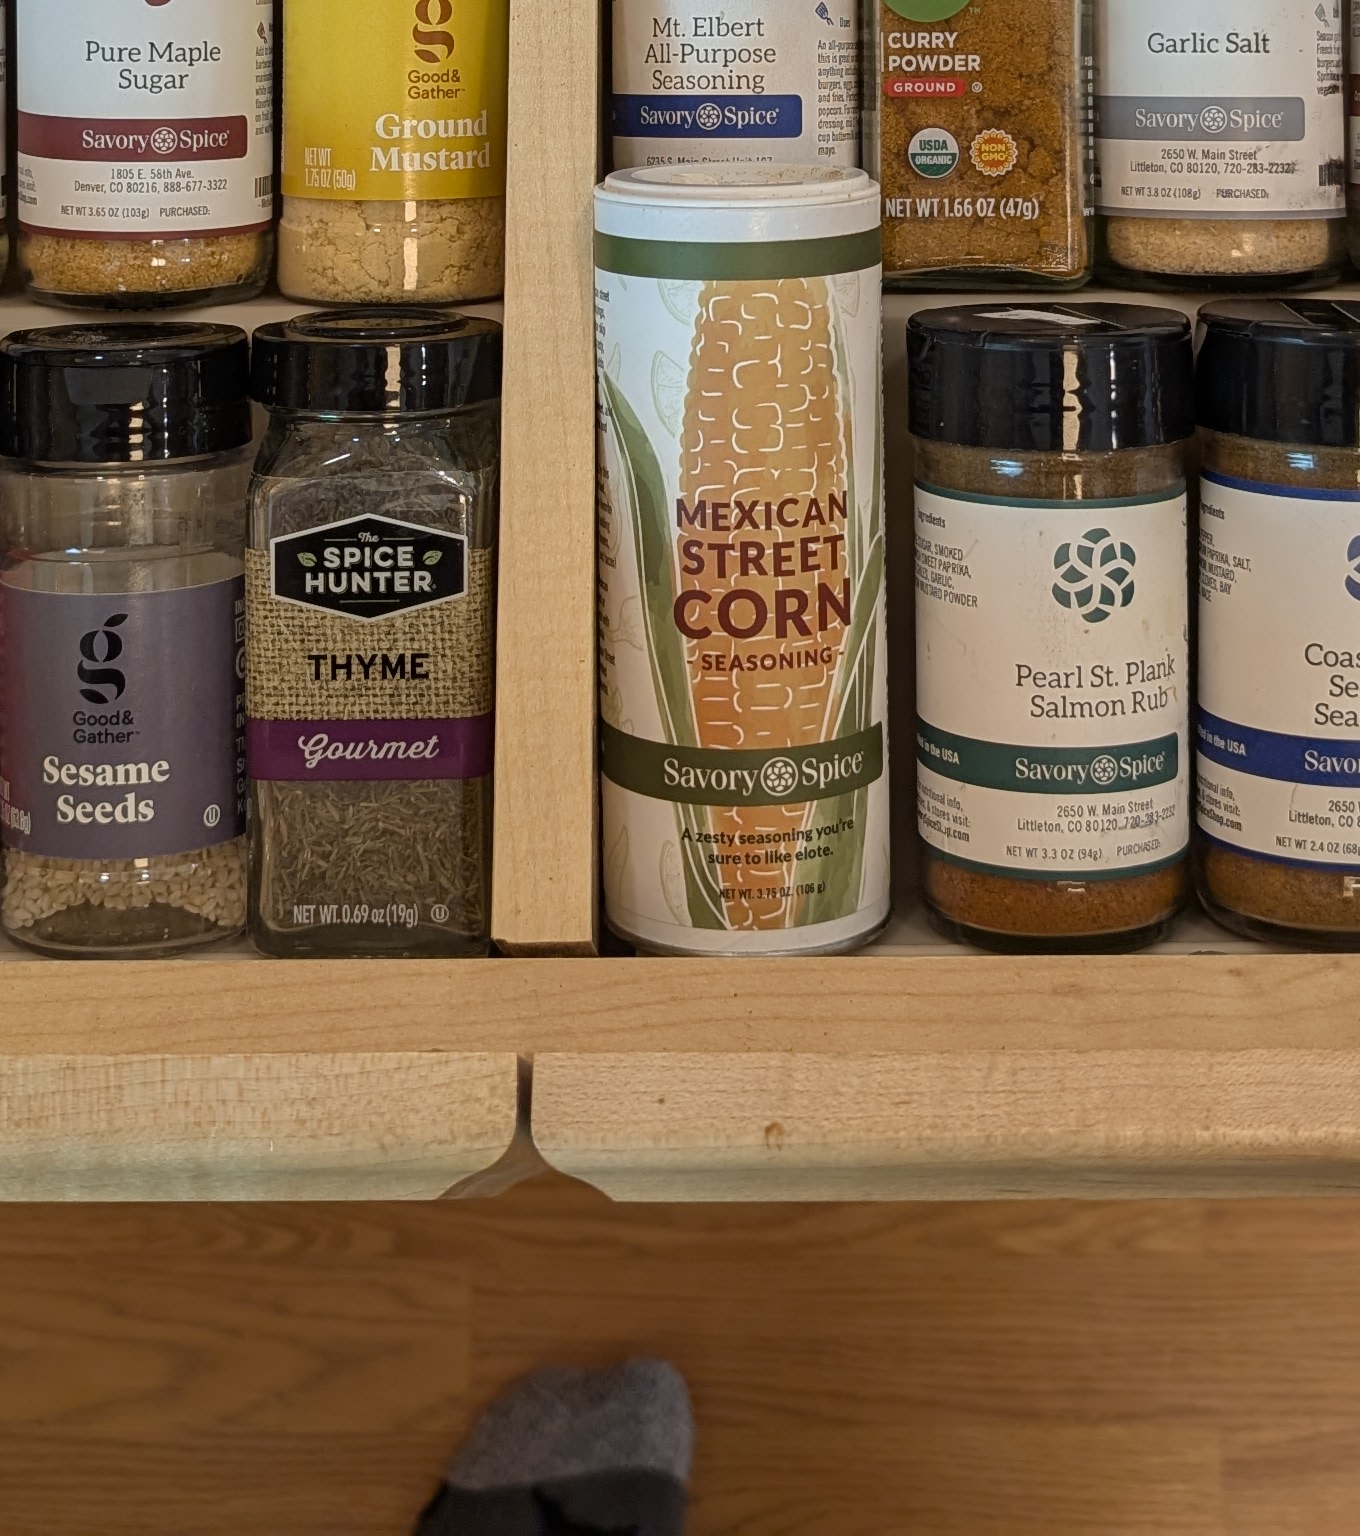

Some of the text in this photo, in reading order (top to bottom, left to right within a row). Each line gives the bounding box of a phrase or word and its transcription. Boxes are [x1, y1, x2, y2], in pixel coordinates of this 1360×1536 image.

[651, 17, 765, 39] Mt. Elbert
[887, 31, 959, 50] CURRY
[85, 41, 222, 68] Pure Maple
[644, 44, 777, 68] All-Purpose
[1147, 31, 1270, 55] Garlic Salt
[887, 54, 981, 73] POWDER
[118, 69, 189, 95] Sugar
[407, 85, 460, 100] Gather
[651, 69, 766, 95] Seasoning
[893, 81, 956, 93] GROUND
[375, 112, 489, 139] Ground
[82, 130, 231, 155] Savory Spice
[919, 138, 949, 152] USDA
[369, 145, 491, 173] Mustard
[74, 179, 228, 194] Denver, CO 80216, 888-677-3322
[110, 168, 194, 179] 1805 E. 58th Ave.
[675, 490, 849, 533] MEXICAN
[323, 546, 415, 569] SPICE
[681, 534, 845, 579] STREET
[305, 570, 434, 595] HUNTER
[673, 578, 851, 641] CORN
[307, 653, 431, 681] THYME
[701, 647, 833, 672] SEASONING
[1015, 654, 1177, 690] Pearl St. Plank
[1029, 689, 1169, 719] Salmon Rub
[298, 733, 440, 770] Gourmet
[43, 755, 171, 786] Sesame
[663, 752, 864, 797] Savory Spice
[56, 792, 155, 826] Seeds
